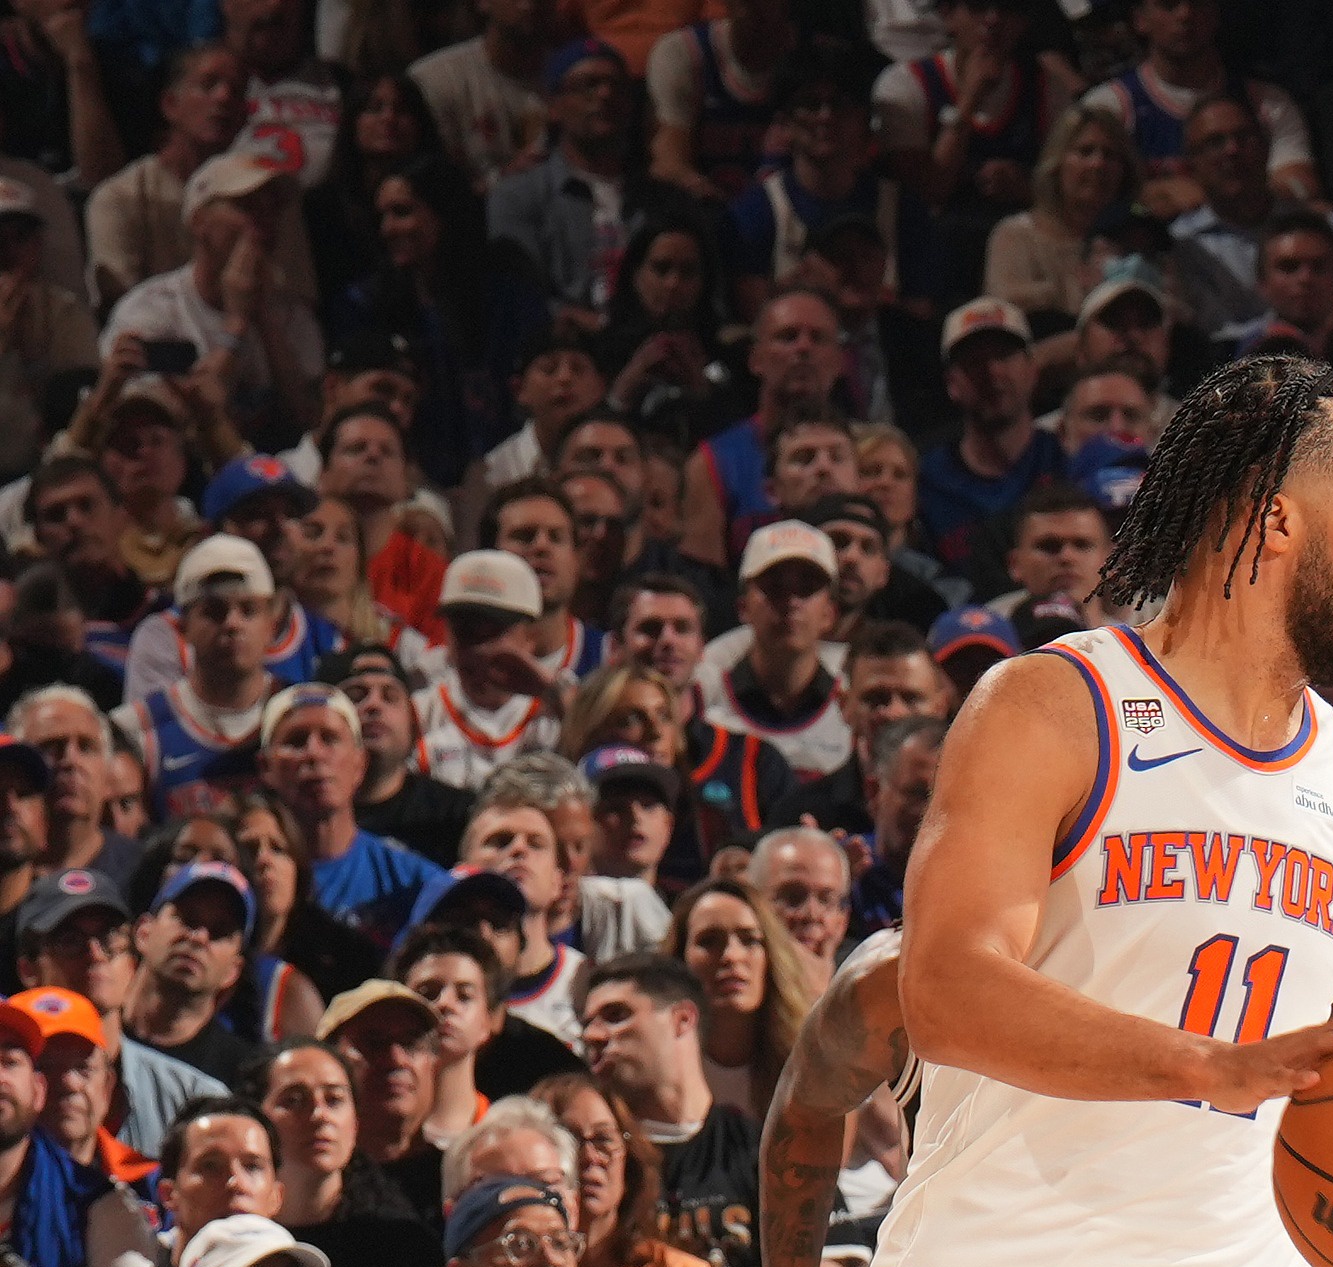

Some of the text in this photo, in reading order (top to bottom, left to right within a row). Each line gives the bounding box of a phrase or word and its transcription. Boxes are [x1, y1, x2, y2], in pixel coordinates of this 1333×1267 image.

[1124, 701, 1160, 712] USA
[1125, 716, 1164, 728] 250
[1295, 794, 1316, 811] abu
[1095, 830, 1246, 909] NEW
[1172, 932, 1291, 1120] 11
